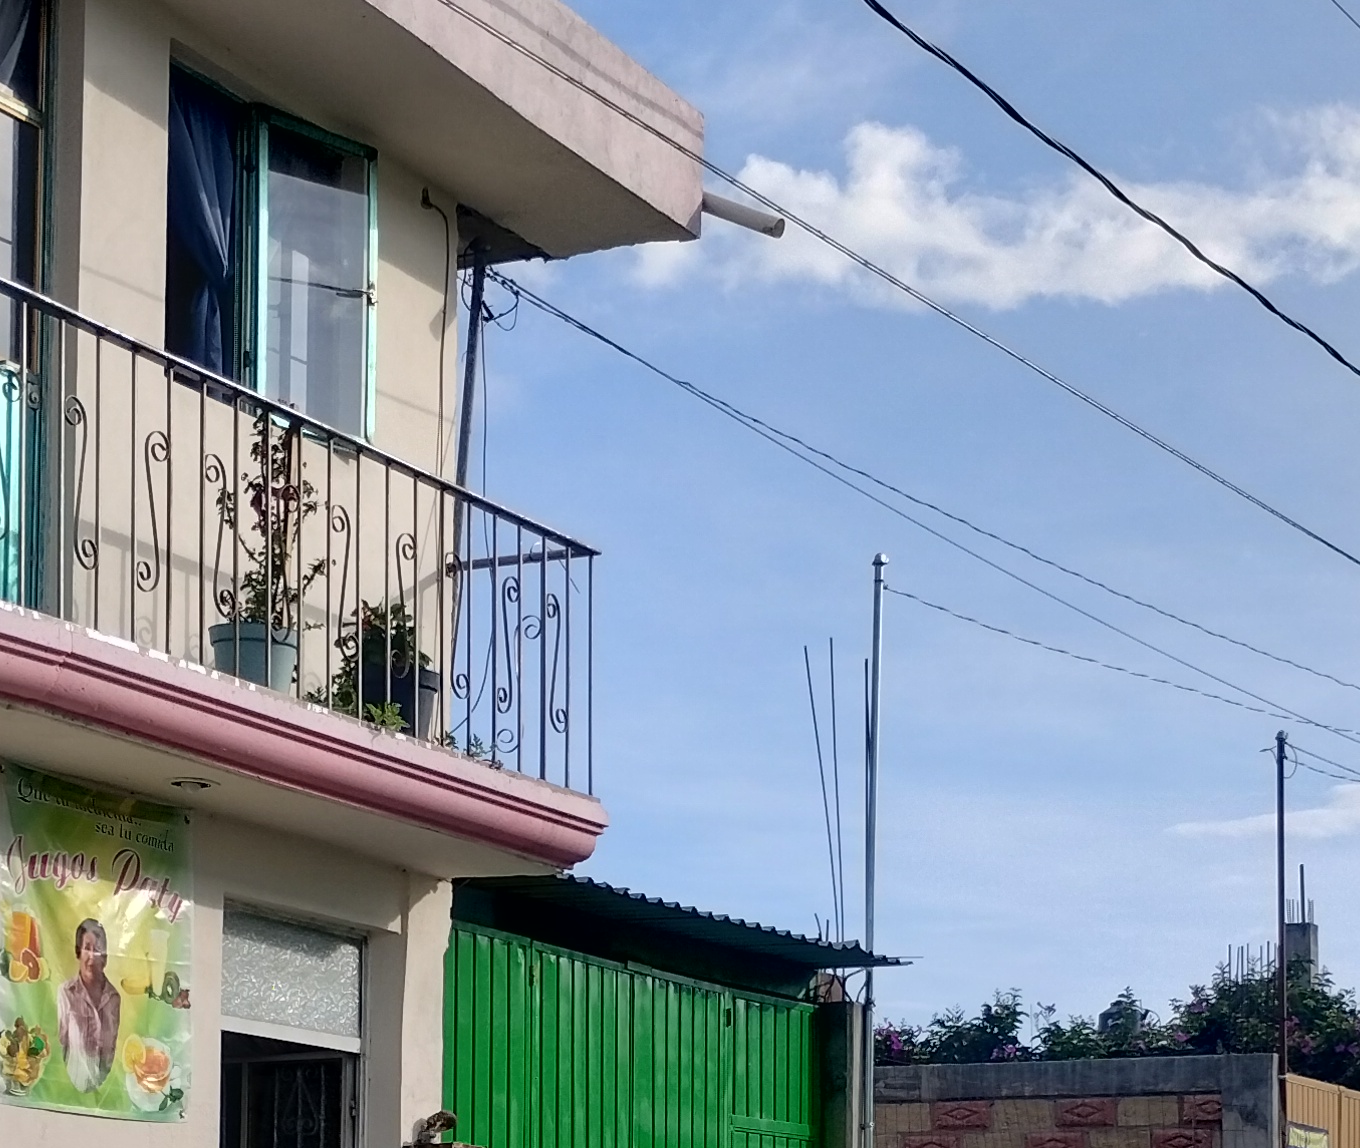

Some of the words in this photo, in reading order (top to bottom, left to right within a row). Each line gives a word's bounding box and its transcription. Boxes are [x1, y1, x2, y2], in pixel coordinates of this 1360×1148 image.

[95, 822, 114, 836] sea
[135, 829, 174, 852] comida
[6, 834, 98, 895] Jugos
[111, 848, 183, 924] Paty
